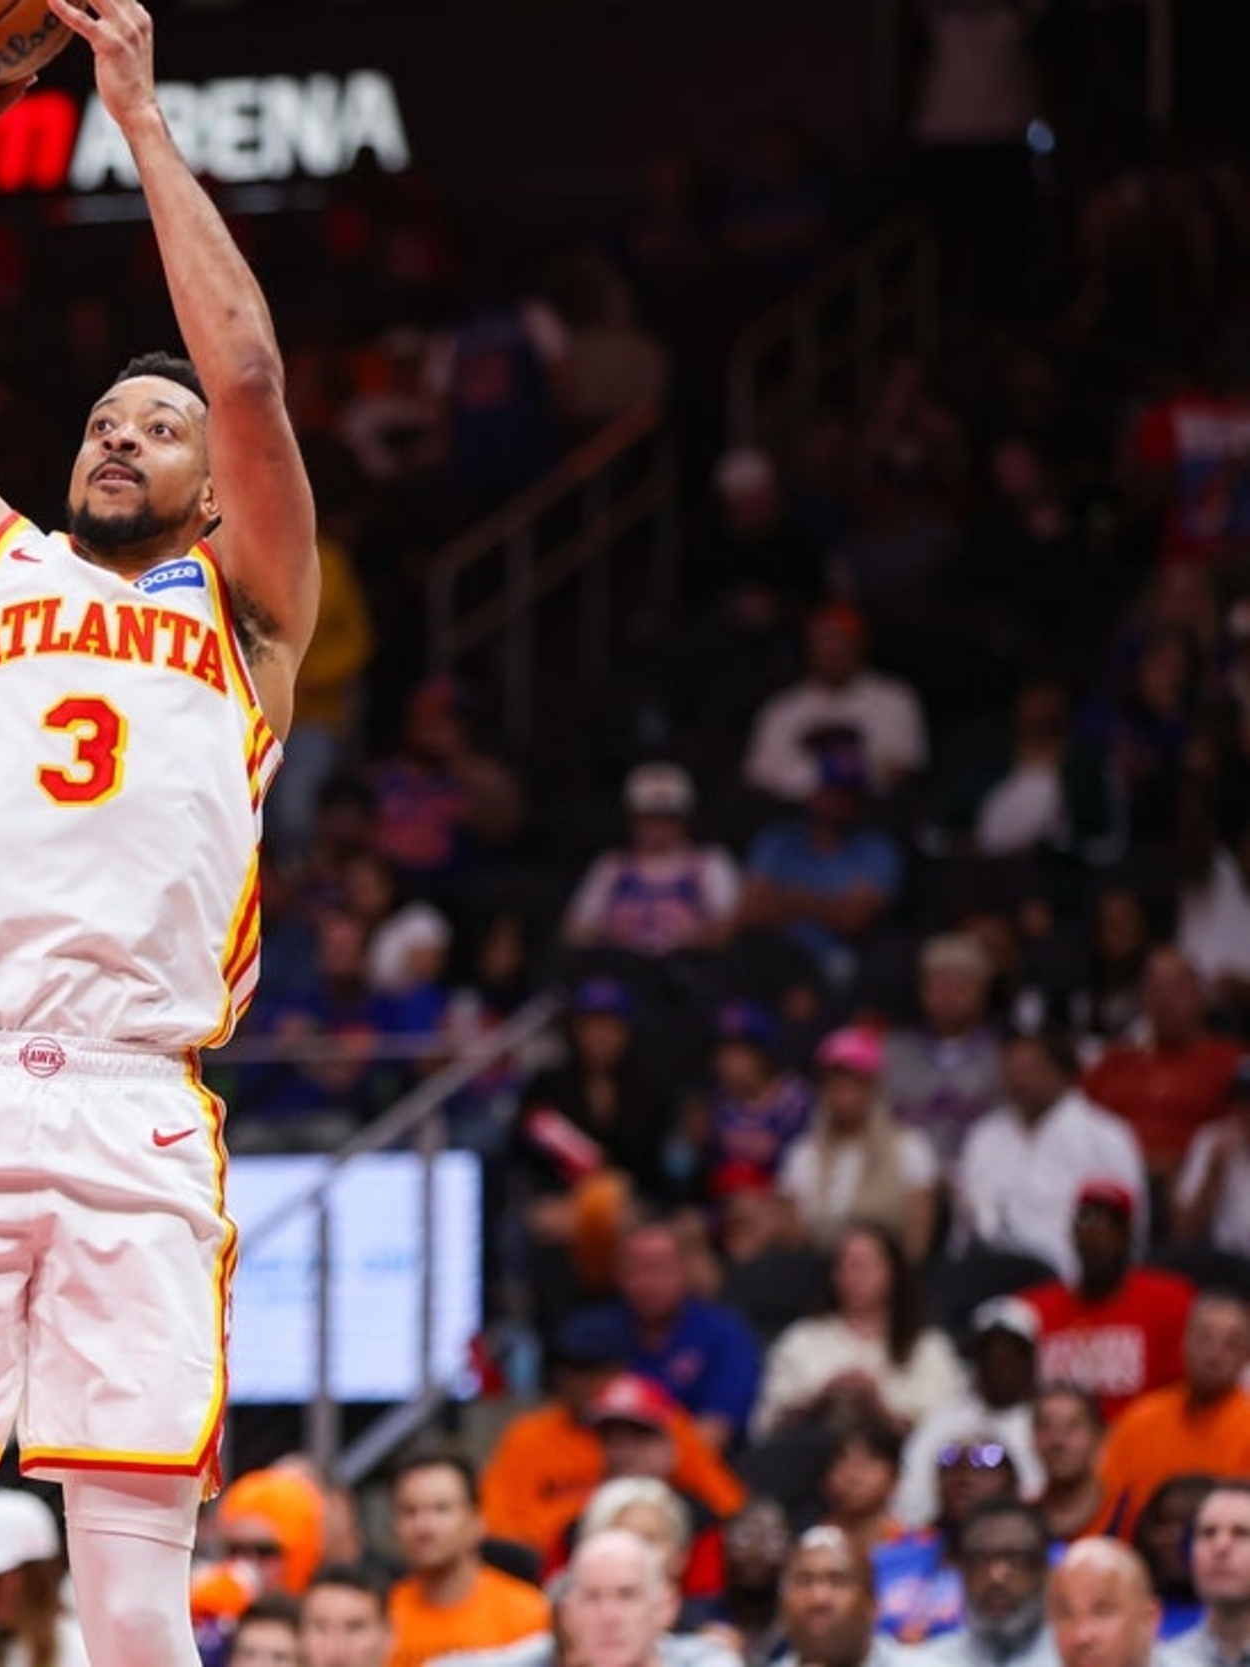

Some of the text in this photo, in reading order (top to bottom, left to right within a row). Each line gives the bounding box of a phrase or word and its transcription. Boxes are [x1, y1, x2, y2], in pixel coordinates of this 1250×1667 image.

[68, 70, 411, 191] ARENA
[37, 695, 128, 806] 3
[19, 1048, 66, 1068] HAWKS
